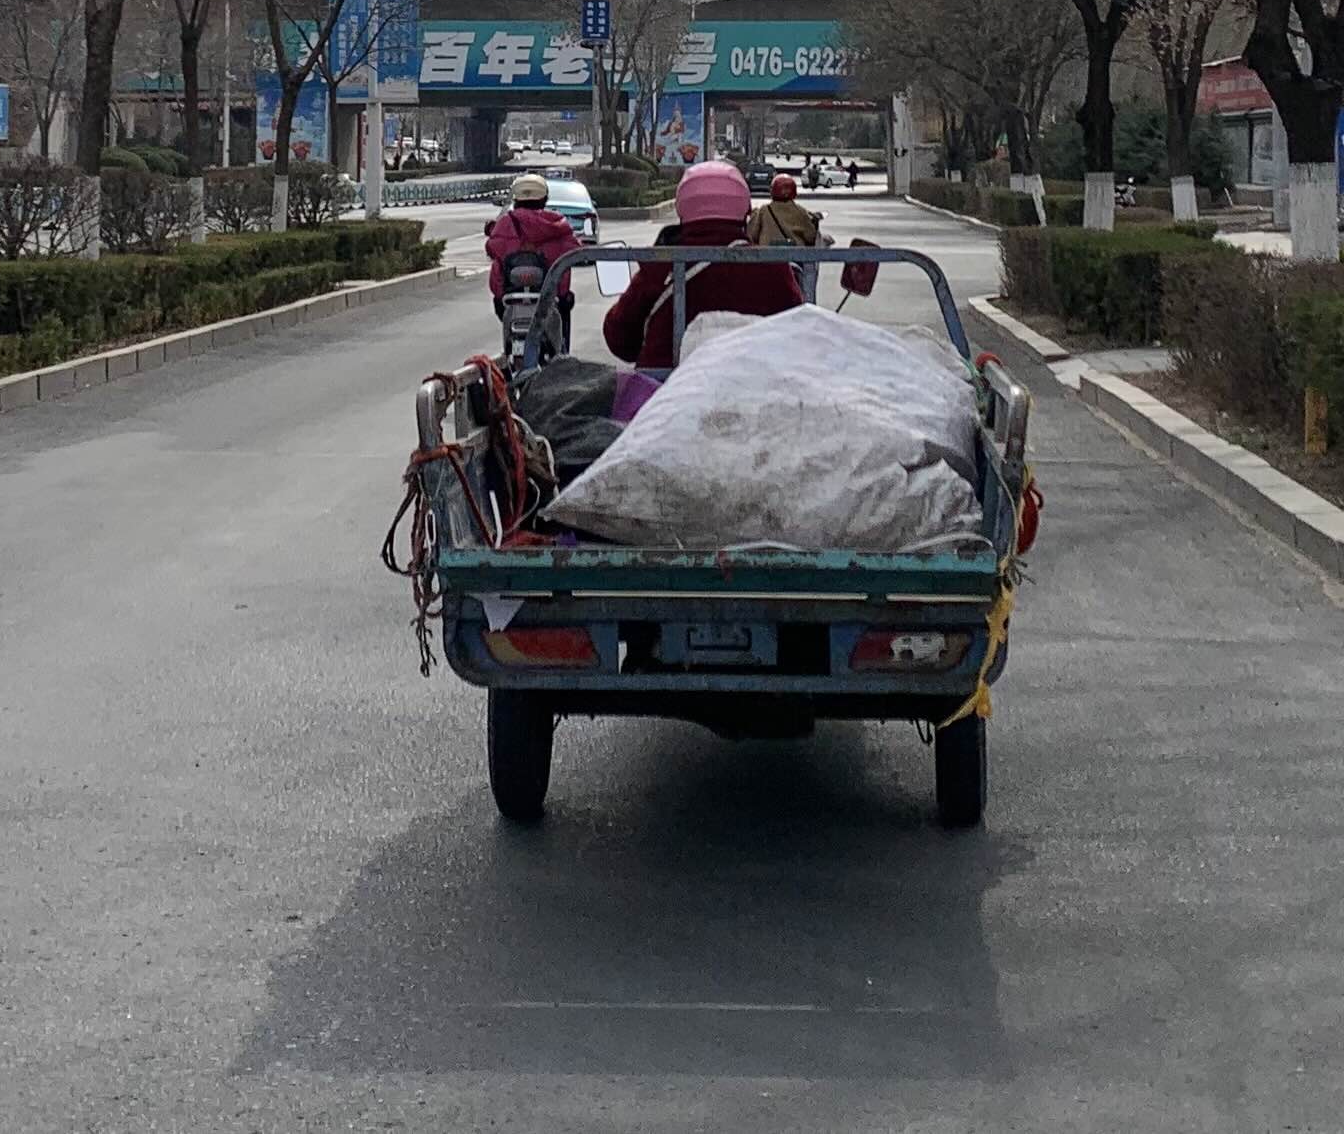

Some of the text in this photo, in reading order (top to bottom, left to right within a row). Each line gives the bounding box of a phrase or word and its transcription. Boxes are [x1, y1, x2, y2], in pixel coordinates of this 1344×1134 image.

[419, 30, 717, 85] 百年老号
[730, 46, 870, 77] 0476-6222
